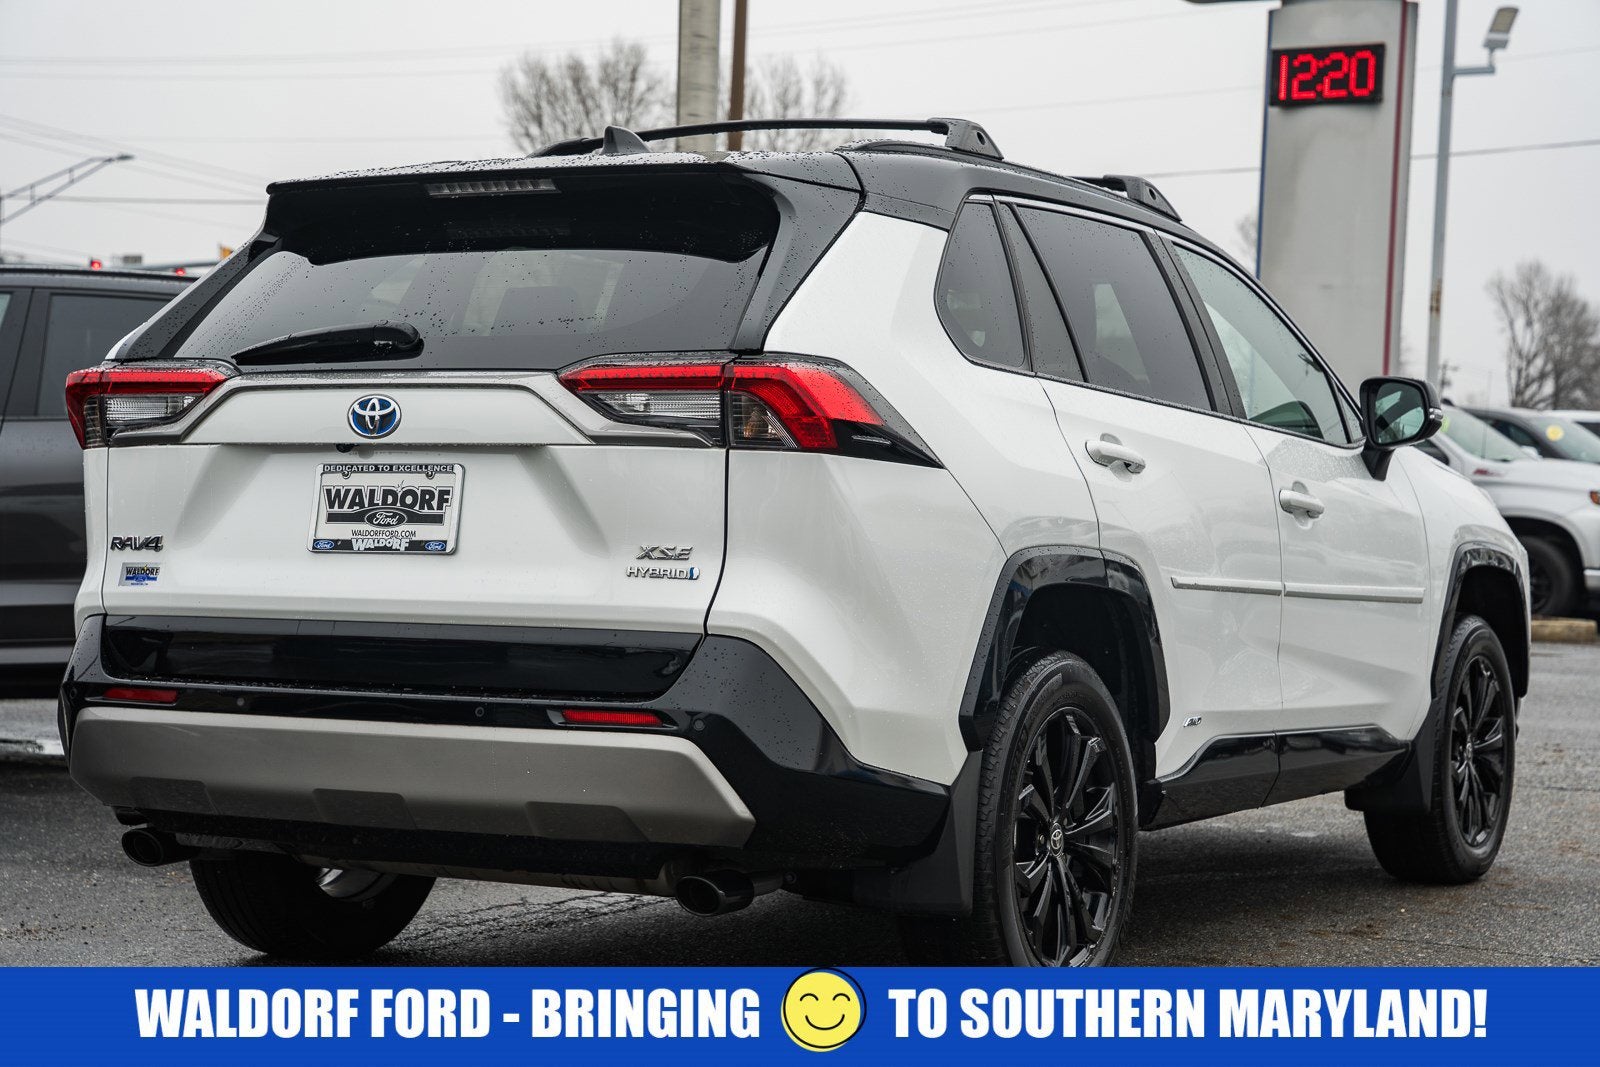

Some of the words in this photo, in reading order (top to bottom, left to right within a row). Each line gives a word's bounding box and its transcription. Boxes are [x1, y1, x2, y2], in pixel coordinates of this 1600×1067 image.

[1279, 51, 1376, 100] 12:20
[324, 487, 452, 511] WALDORF
[372, 512, 400, 525] Ford
[351, 529, 417, 538] WALDORFFORD.COM
[110, 535, 164, 552] RAV4
[315, 541, 334, 550] Ford
[351, 537, 410, 551] WALDORF
[426, 541, 446, 550] Ford
[635, 545, 693, 560] XSE
[125, 566, 160, 576] WALDORF
[626, 566, 688, 580] HYBRID
